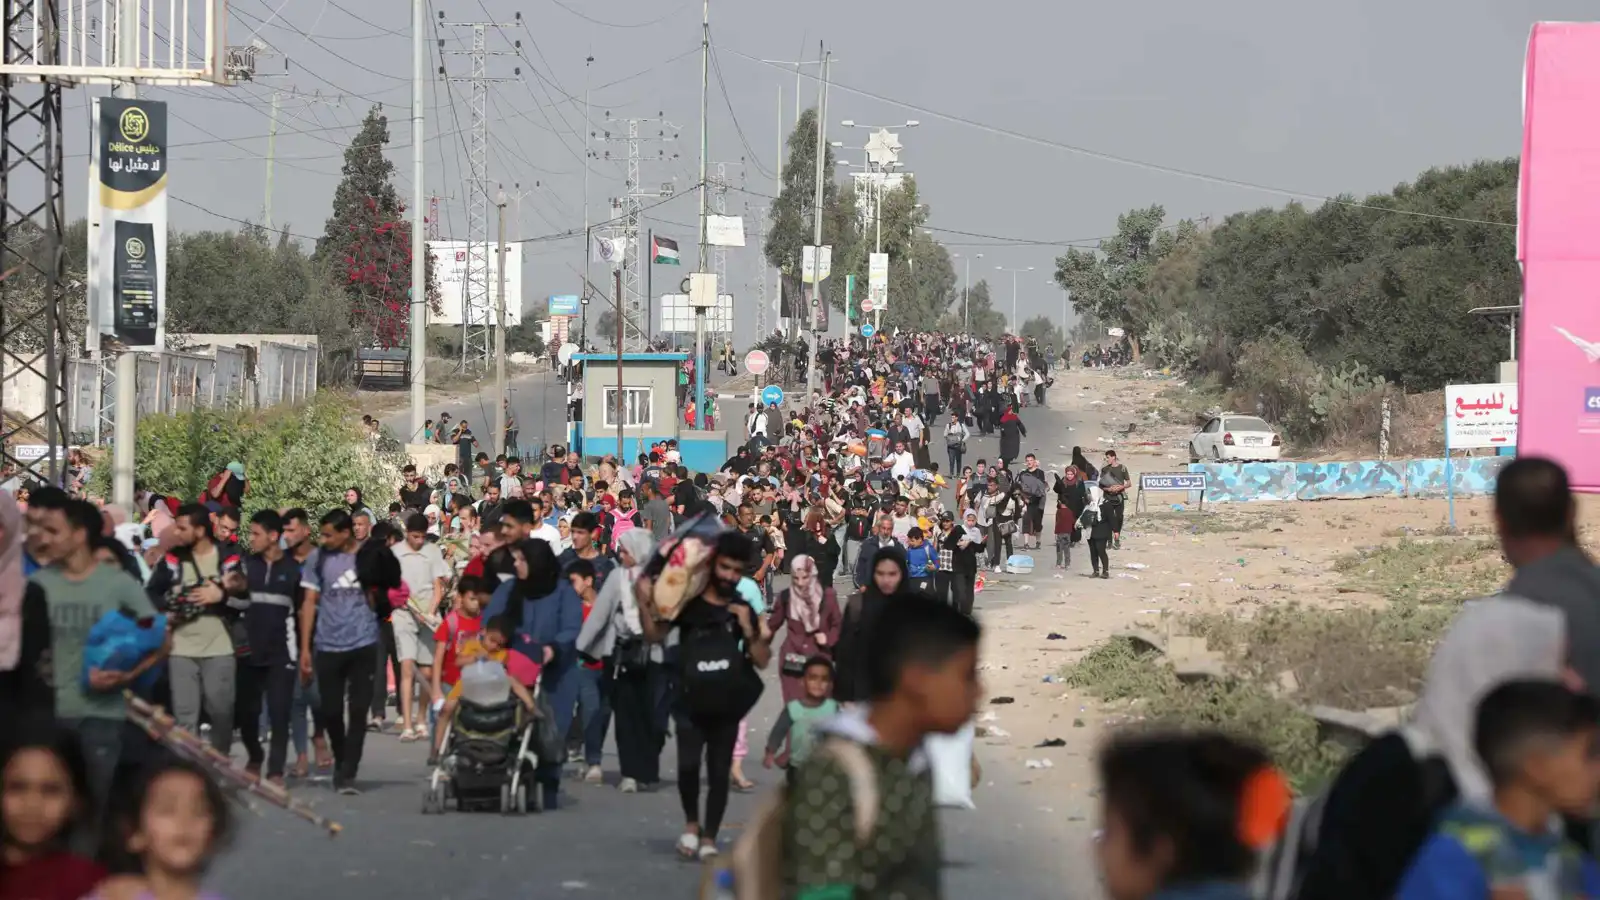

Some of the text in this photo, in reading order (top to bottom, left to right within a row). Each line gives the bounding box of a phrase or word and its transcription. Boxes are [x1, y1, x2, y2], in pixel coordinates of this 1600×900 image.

[108, 142, 134, 153] Délice
[135, 144, 160, 155] ديليس
[108, 156, 160, 173] لا مثيل لها
[1455, 392, 1505, 418] للبيع
[1146, 478, 1172, 487] POLICE
[1175, 476, 1202, 488] شرطة
